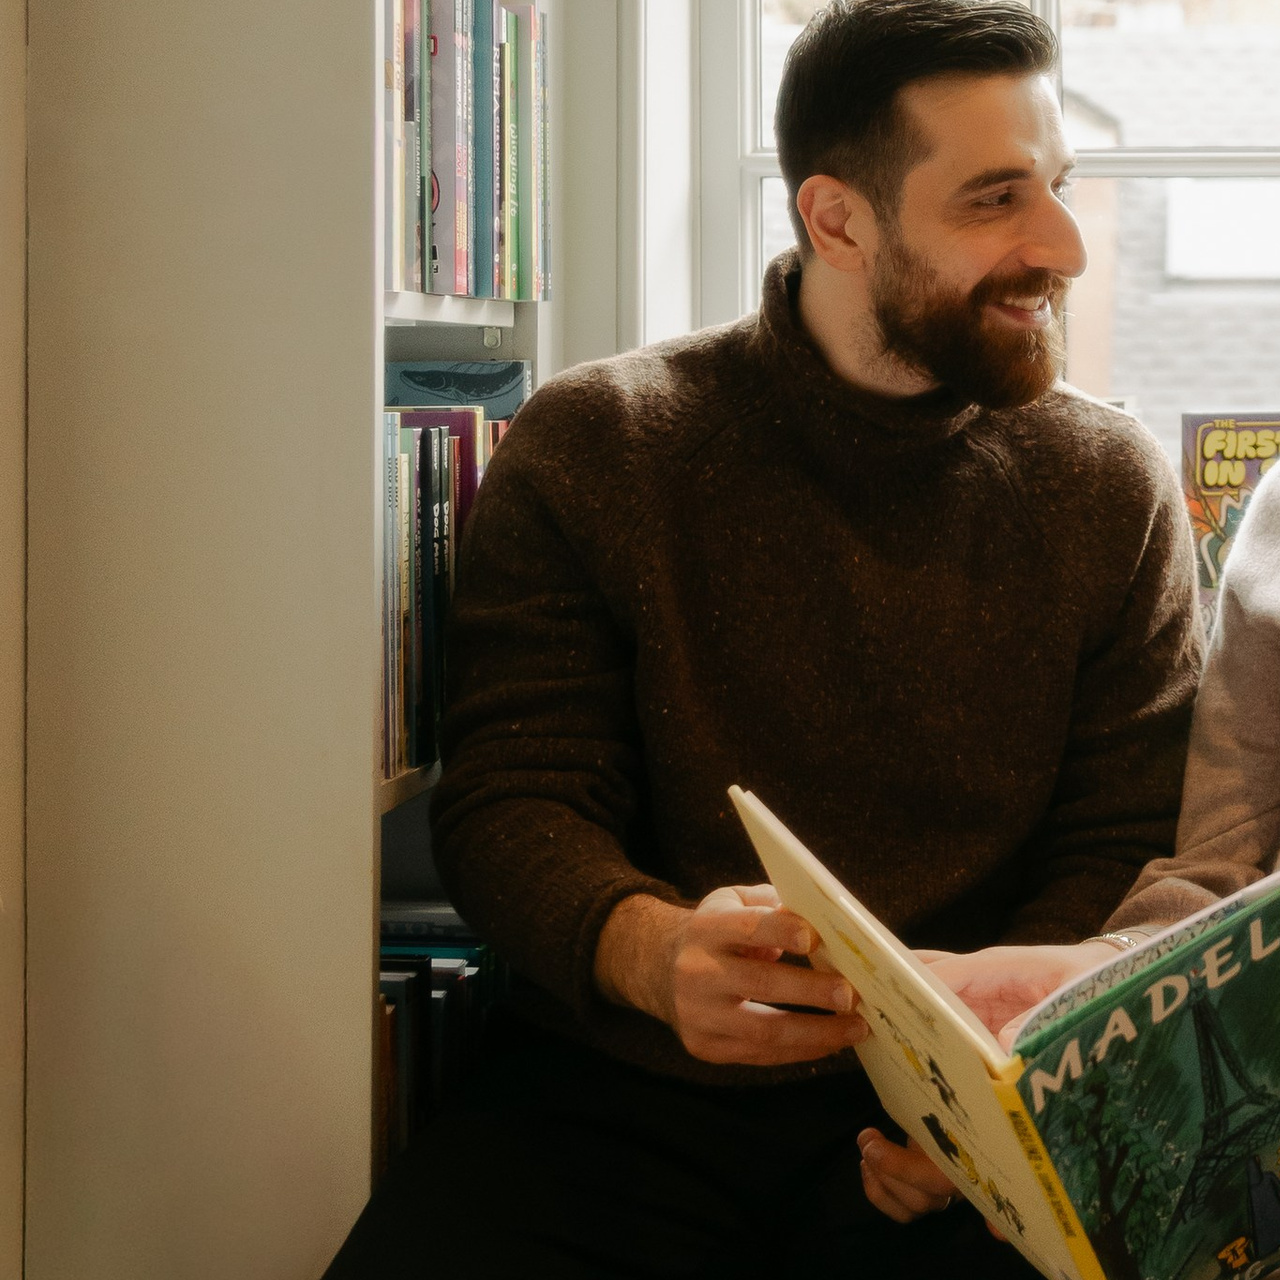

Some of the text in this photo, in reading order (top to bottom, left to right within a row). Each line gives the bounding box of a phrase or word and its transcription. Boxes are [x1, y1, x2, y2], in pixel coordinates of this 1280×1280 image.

[1213, 419, 1236, 429] THE
[1203, 460, 1246, 487] IN
[432, 503, 440, 538] DOG
